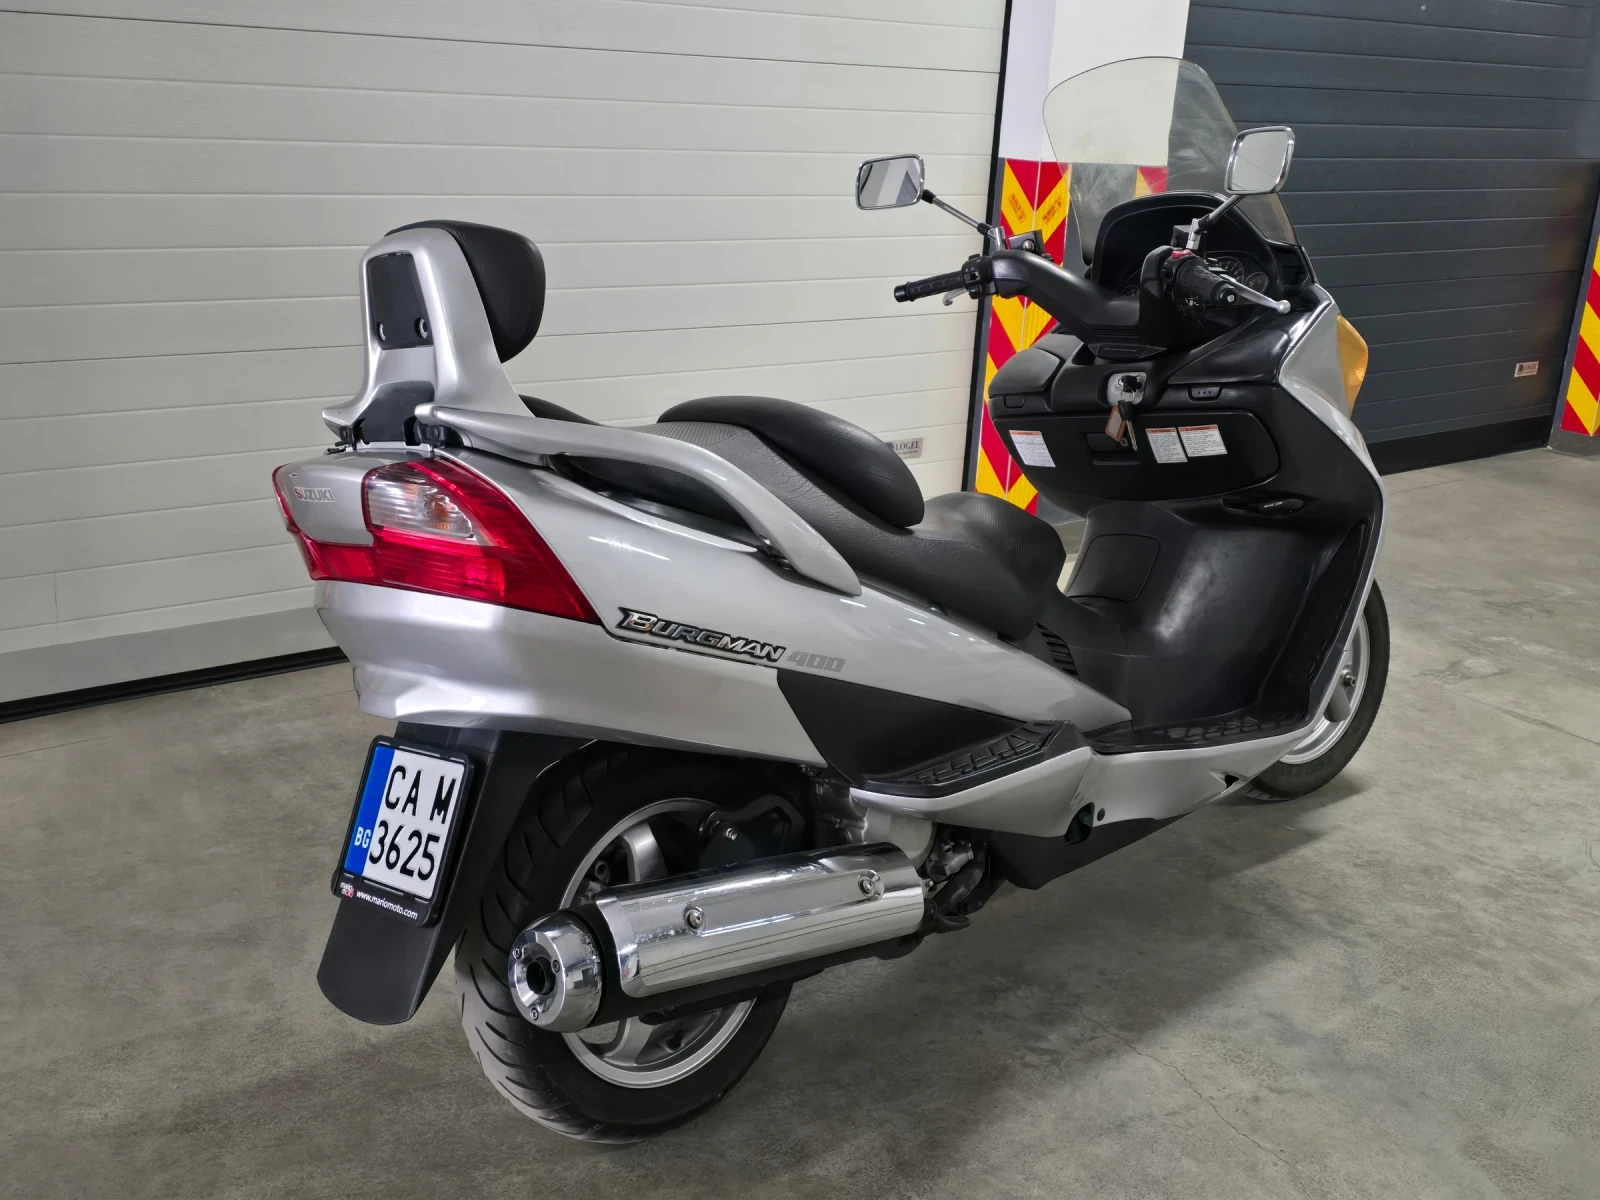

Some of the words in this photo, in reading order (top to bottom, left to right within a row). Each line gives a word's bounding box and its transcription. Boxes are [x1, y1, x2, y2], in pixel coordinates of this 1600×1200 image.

[294, 487, 335, 502] SUZUKI
[619, 608, 787, 662] BURGMAN
[787, 651, 846, 673] 400
[385, 765, 422, 816] CA
[429, 775, 456, 825] M
[354, 826, 372, 849] BG
[369, 820, 440, 881] 3625
[356, 890, 418, 920] www.mariomoto.com
